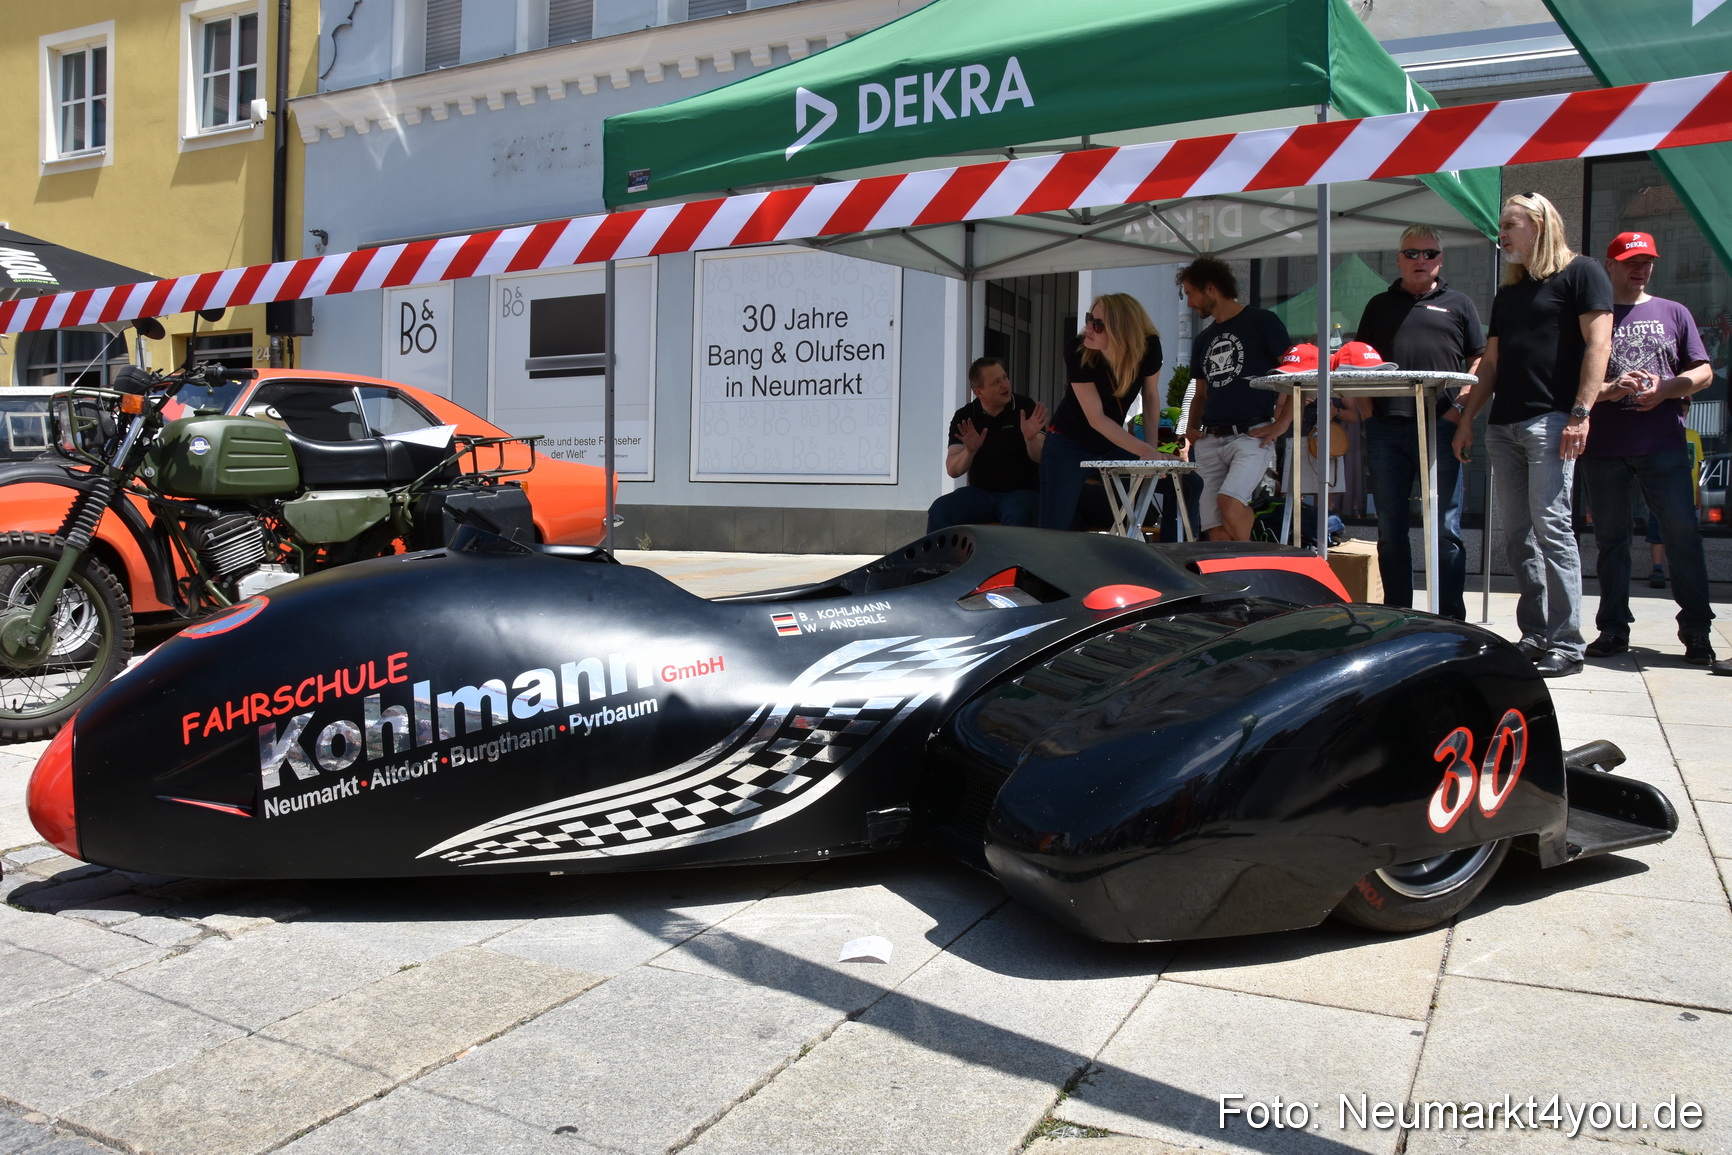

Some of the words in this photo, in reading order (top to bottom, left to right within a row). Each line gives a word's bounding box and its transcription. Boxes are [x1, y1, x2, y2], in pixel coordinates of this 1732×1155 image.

[858, 56, 1035, 134] DEKRA
[1625, 240, 1648, 250] DEKRA
[742, 304, 776, 332] 30
[784, 307, 848, 331] Jahre
[1612, 323, 1665, 338] ictoria
[256, 346, 270, 361] 24
[708, 344, 763, 370] Bang
[771, 341, 787, 363] &
[795, 339, 885, 363] Olufsen
[725, 376, 743, 397] in
[752, 372, 863, 397] Neumarkt
[557, 437, 572, 446] und
[574, 437, 596, 446] beste
[598, 434, 641, 446] Fnseher
[551, 449, 564, 459] der
[798, 611, 814, 622] B.
[816, 601, 892, 620] KOHLMANN
[802, 622, 824, 634] W.
[829, 613, 888, 630] ANDERLE
[182, 651, 409, 745] FAHRSCHULE
[258, 650, 655, 791] Kohlmann
[660, 655, 726, 683] GmbH
[263, 775, 360, 819] Neumarkt
[370, 752, 439, 790] Altdorf
[450, 723, 558, 768] Burgthann
[569, 698, 659, 737] Pyrbaum
[1427, 708, 1528, 834] 30
